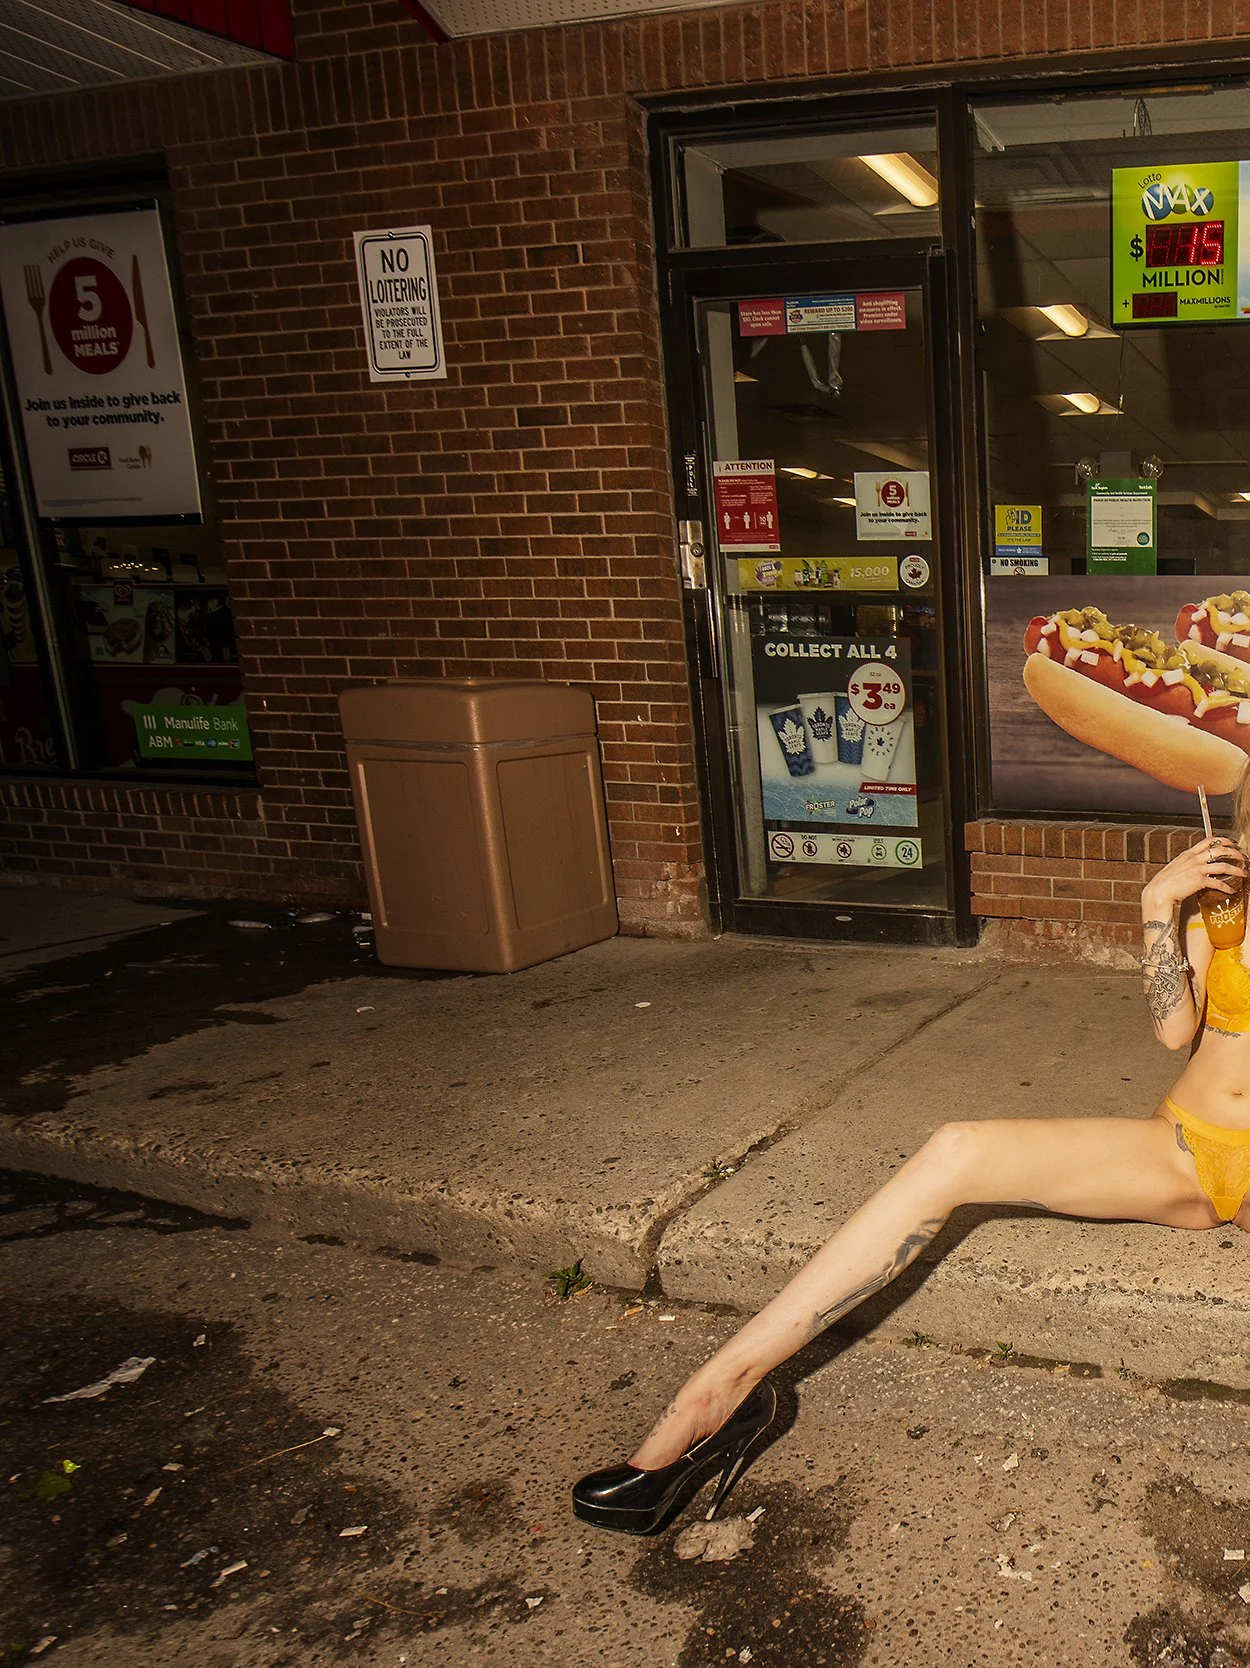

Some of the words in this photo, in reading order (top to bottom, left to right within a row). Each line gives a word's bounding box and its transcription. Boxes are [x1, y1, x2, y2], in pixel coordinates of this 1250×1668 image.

[1137, 172, 1163, 189] Lotto
[1141, 183, 1213, 220] MAX
[47, 238, 70, 264] HELP
[72, 236, 86, 248] US
[89, 238, 115, 259] GIVE
[1129, 233, 1145, 261] $
[1189, 224, 1223, 265] 15
[380, 248, 409, 273] NO
[1141, 268, 1222, 288] MILLION
[369, 277, 427, 304] LOITERING
[73, 274, 104, 322] 5
[1179, 296, 1232, 306] MAXMILLIONS
[374, 306, 410, 318] VIOLATORS
[411, 306, 427, 315] WILL
[375, 319, 386, 329] BE
[386, 317, 428, 328] PROSECUTED
[70, 324, 118, 341] million
[382, 330, 391, 339] TO
[393, 329, 405, 339] THE
[406, 328, 424, 338] FULL
[379, 340, 404, 350] EXTENT
[405, 339, 413, 349] OF
[415, 339, 429, 348] THE
[398, 350, 411, 360] LAW
[25, 398, 50, 413] Join
[51, 397, 67, 410] us
[69, 395, 105, 410] inside
[106, 395, 121, 408] to
[121, 393, 149, 412] give
[151, 390, 181, 405] back
[46, 415, 61, 428] to
[62, 414, 90, 430] your
[91, 409, 165, 427] community.
[71, 453, 97, 465] CIRCLE
[724, 462, 773, 471] ATTENTION
[888, 484, 898, 496] 5
[1015, 510, 1032, 525] ID
[1000, 559, 1009, 567] NO
[1009, 559, 1039, 567] SMOKING
[849, 566, 890, 580] 15,000
[764, 642, 843, 659] COLLECT
[846, 643, 882, 660] ALL
[884, 644, 898, 660] 4
[883, 702, 896, 710] ea
[163, 715, 211, 731] Manulife
[213, 717, 240, 732] Bank
[148, 735, 174, 749] ABM
[805, 800, 836, 811] FROSTER
[901, 846, 914, 859] 24
